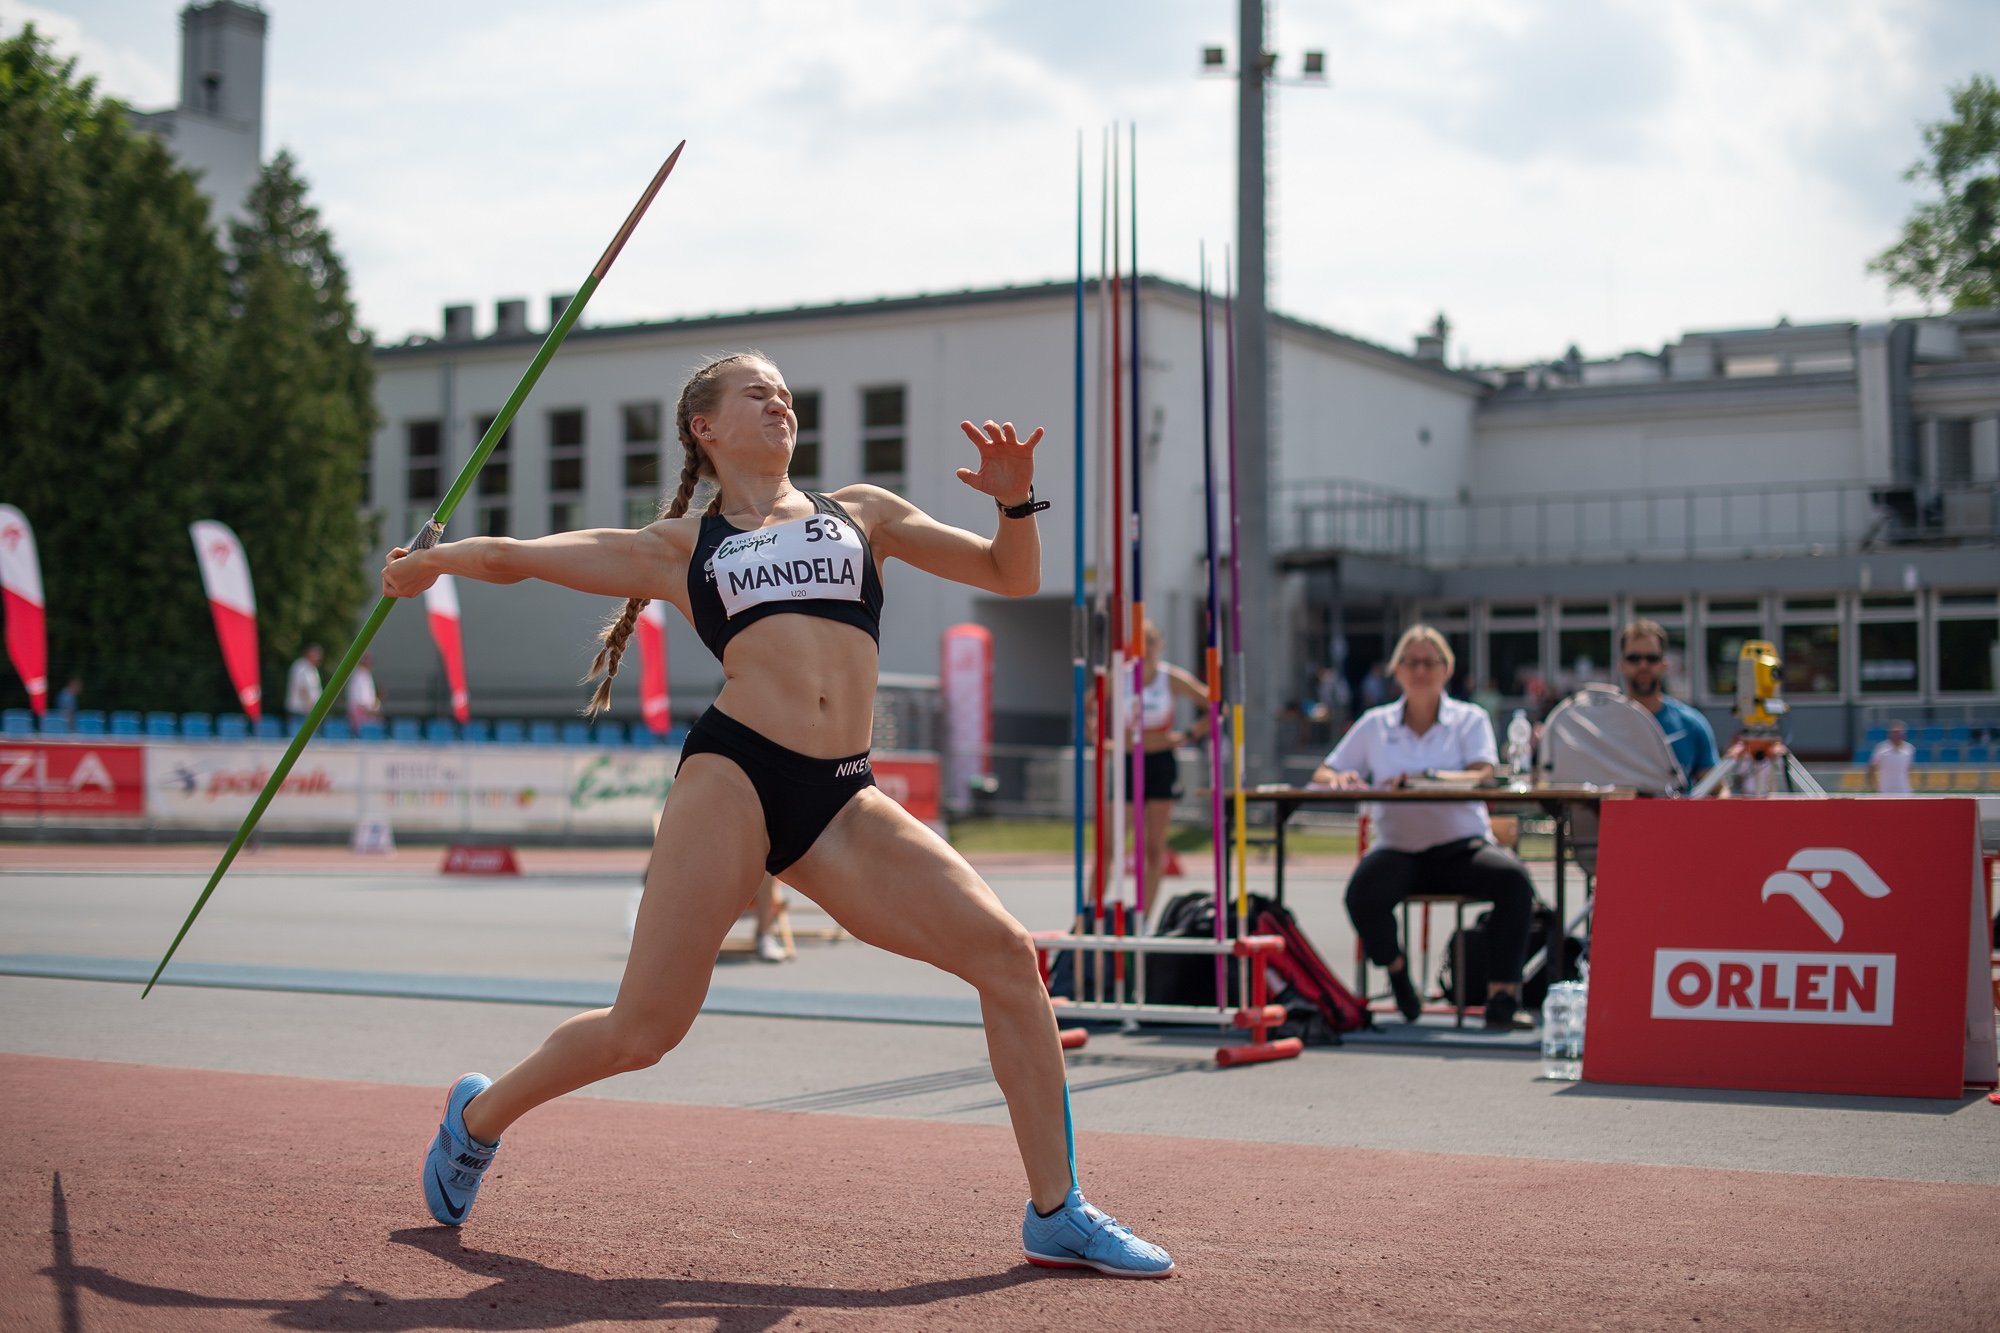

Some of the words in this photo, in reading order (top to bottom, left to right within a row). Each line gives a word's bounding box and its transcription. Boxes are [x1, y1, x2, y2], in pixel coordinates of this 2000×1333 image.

[805, 518, 842, 543] 53
[717, 533, 778, 559] Europol
[728, 557, 856, 597] MANDELA
[790, 589, 807, 598] U20
[835, 757, 867, 778] NIKE
[1666, 960, 1879, 1014] ORLEN
[455, 1152, 491, 1170] NIKE
